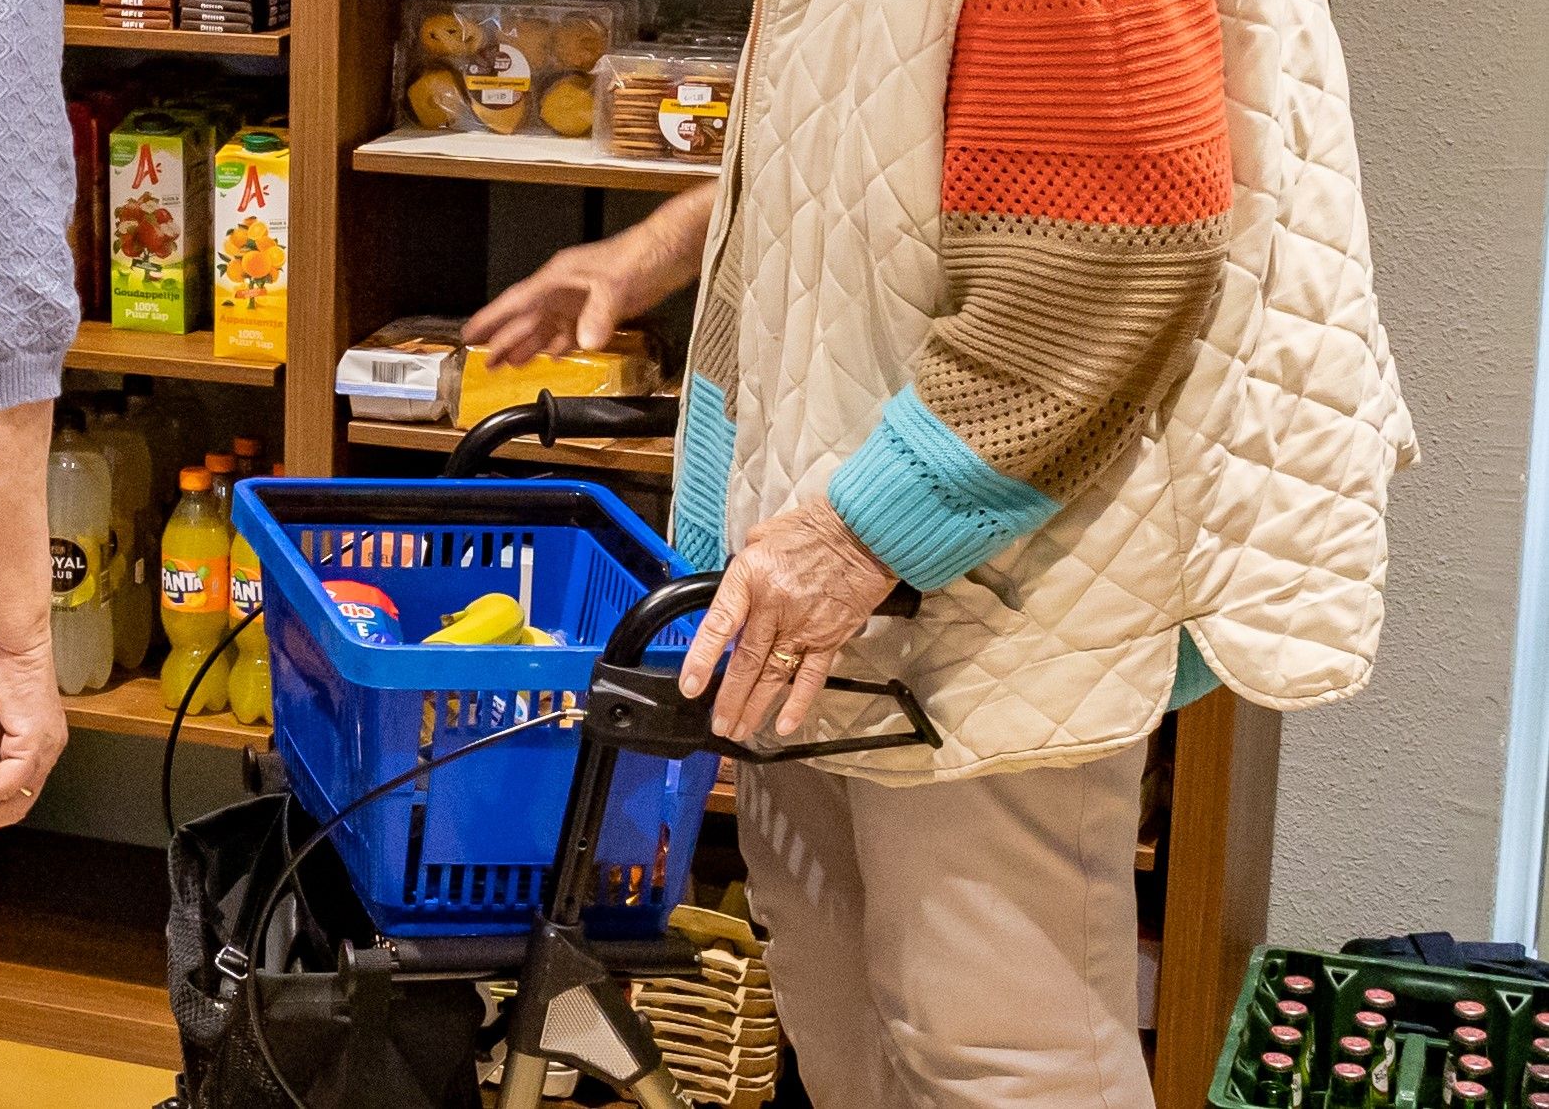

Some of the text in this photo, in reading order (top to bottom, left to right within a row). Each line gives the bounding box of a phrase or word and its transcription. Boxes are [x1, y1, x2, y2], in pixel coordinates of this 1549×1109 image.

[113, 287, 180, 302] Goudappeltje
[51, 556, 86, 570] YAL
[51, 570, 73, 580] LUB
[161, 567, 204, 593] FANTA
[231, 578, 263, 603] FANT
